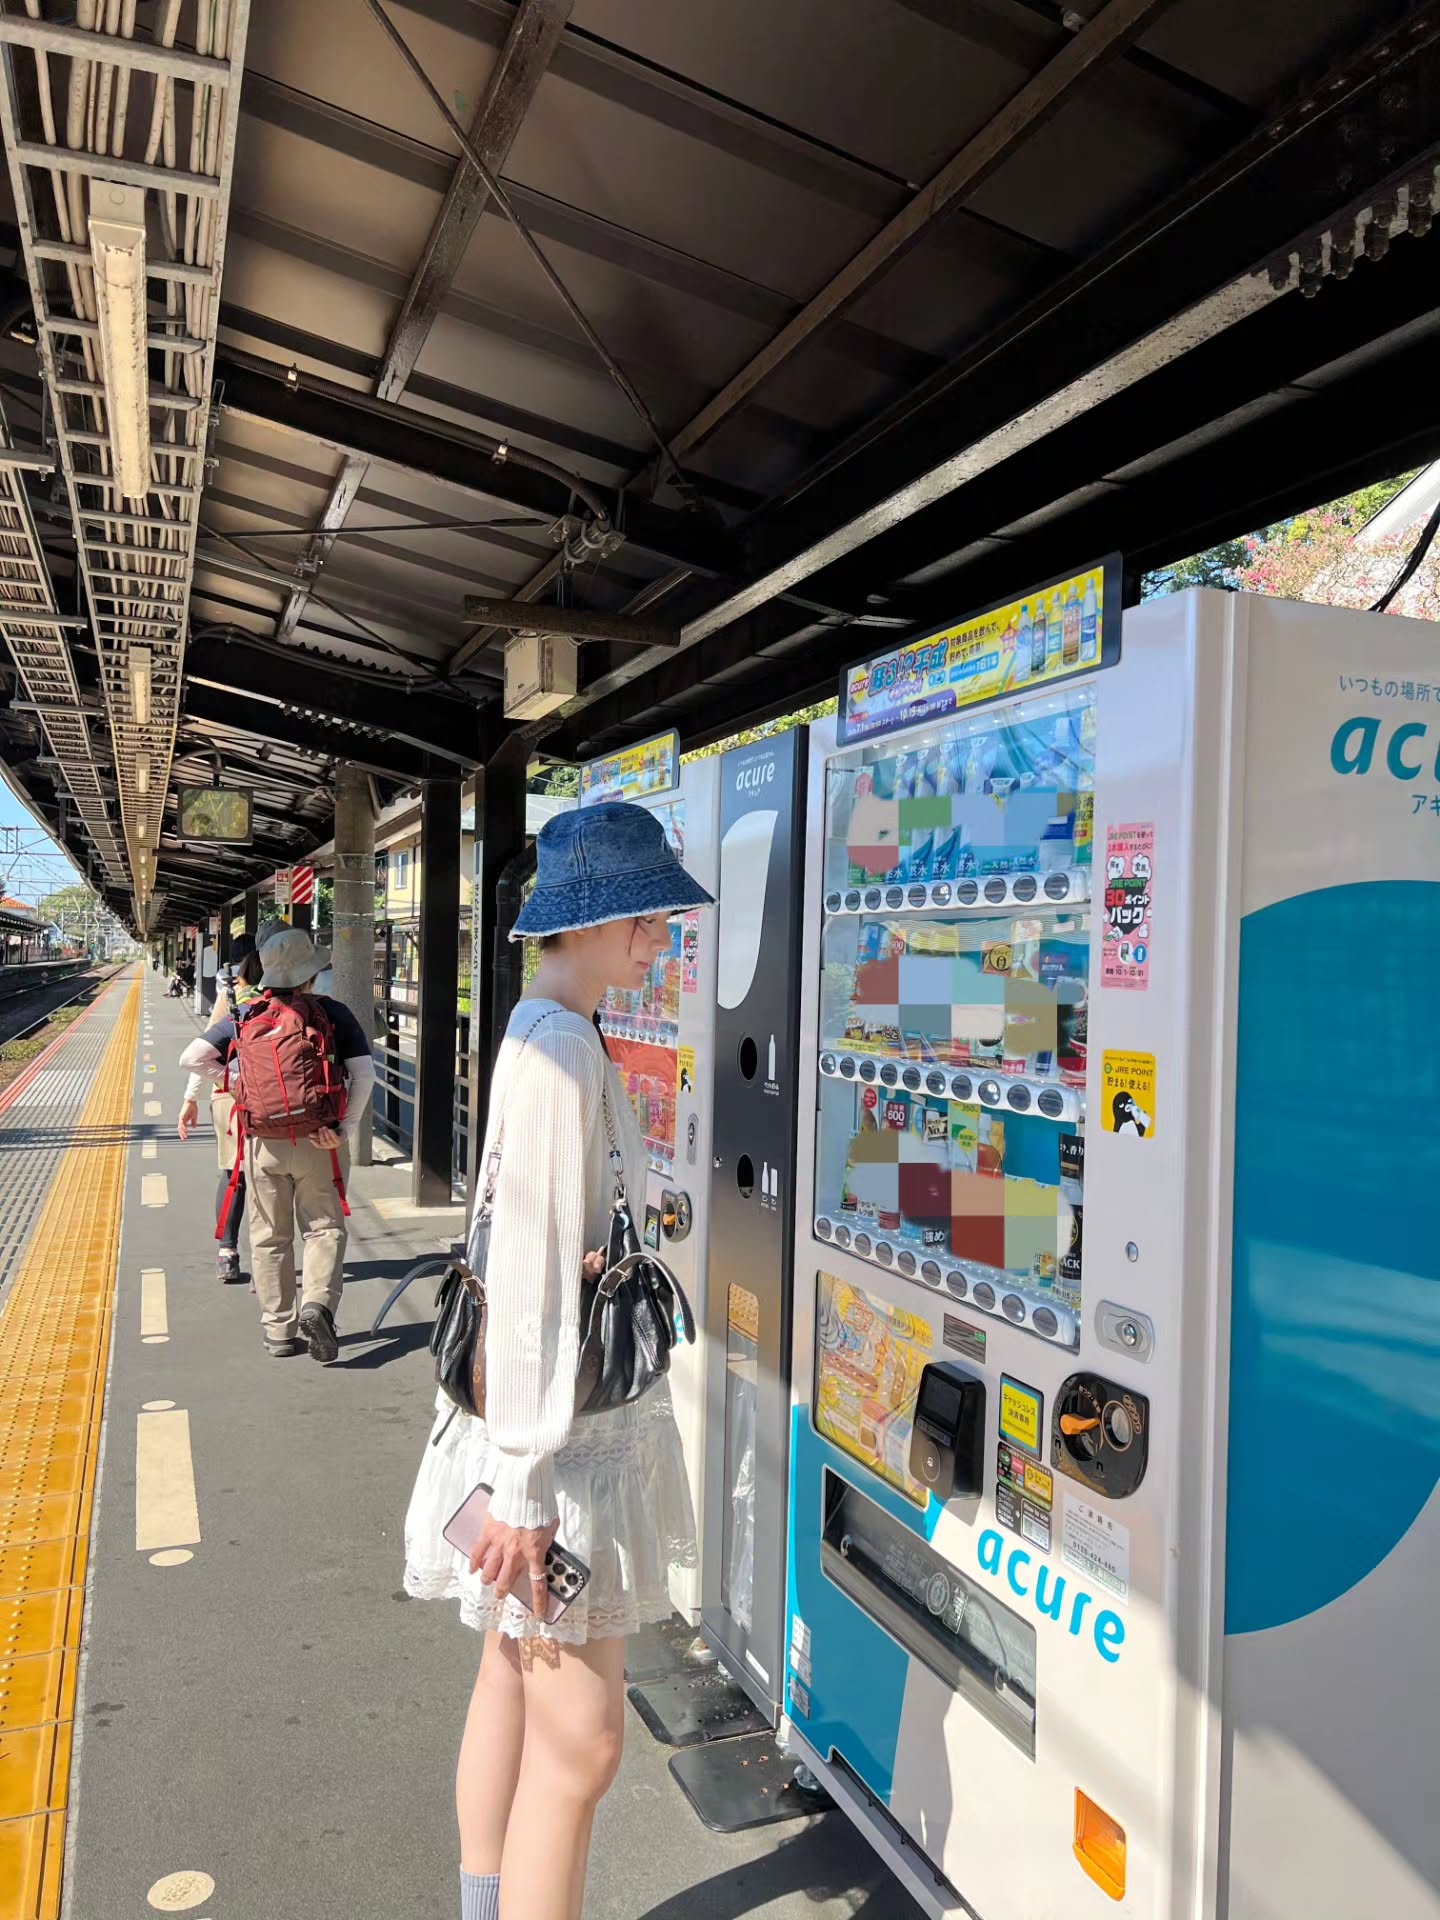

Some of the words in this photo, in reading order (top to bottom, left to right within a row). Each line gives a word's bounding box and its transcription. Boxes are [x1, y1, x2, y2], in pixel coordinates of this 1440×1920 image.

[1330, 717, 1440, 783] ac
[736, 762, 775, 791] acure
[1124, 878, 1147, 888] POINT
[1110, 906, 1144, 924] バック
[1131, 1067, 1153, 1076] POINT
[887, 1110, 905, 1122] 600
[925, 1230, 944, 1243] 強め
[977, 1528, 1126, 1664] acure
